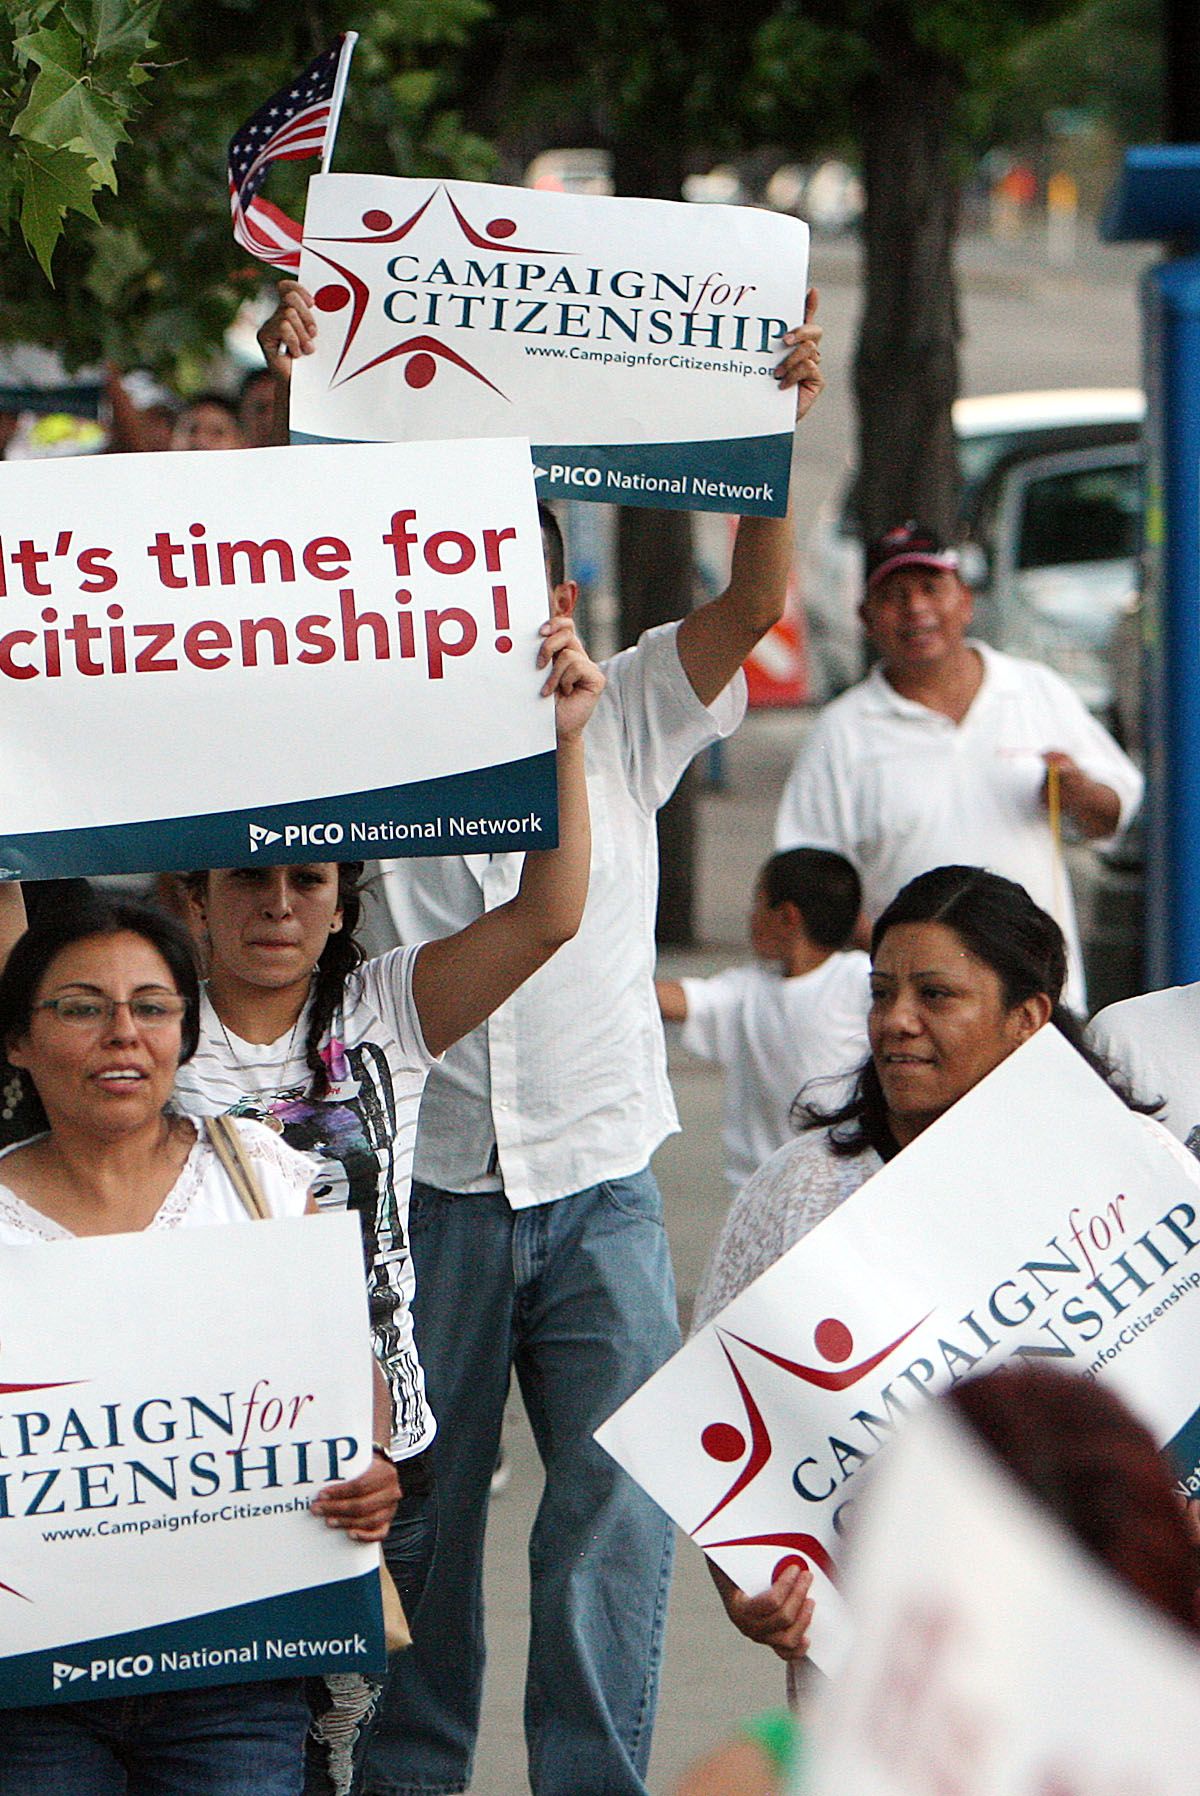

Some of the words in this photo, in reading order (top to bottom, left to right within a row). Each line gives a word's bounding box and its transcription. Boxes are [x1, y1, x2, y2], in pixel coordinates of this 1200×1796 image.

[386, 255, 695, 303] CAMPAIGN
[681, 271, 757, 316] for
[383, 289, 789, 354] CITIZENSHIP
[525, 344, 779, 378] www.CampaignforCitizenship.or
[550, 464, 601, 487] PICO
[607, 470, 687, 494] National
[692, 477, 774, 501] Network
[147, 522, 352, 589] time
[382, 509, 517, 576] for
[284, 823, 344, 847] PICO
[350, 817, 442, 842] National
[449, 812, 542, 837] Network
[1069, 1193, 1126, 1290] for
[225, 1379, 314, 1456] for
[42, 1495, 314, 1541] www.CampaignforCitizenshi
[90, 1654, 153, 1682] PICO
[160, 1641, 258, 1672] National
[265, 1633, 367, 1660] Network
